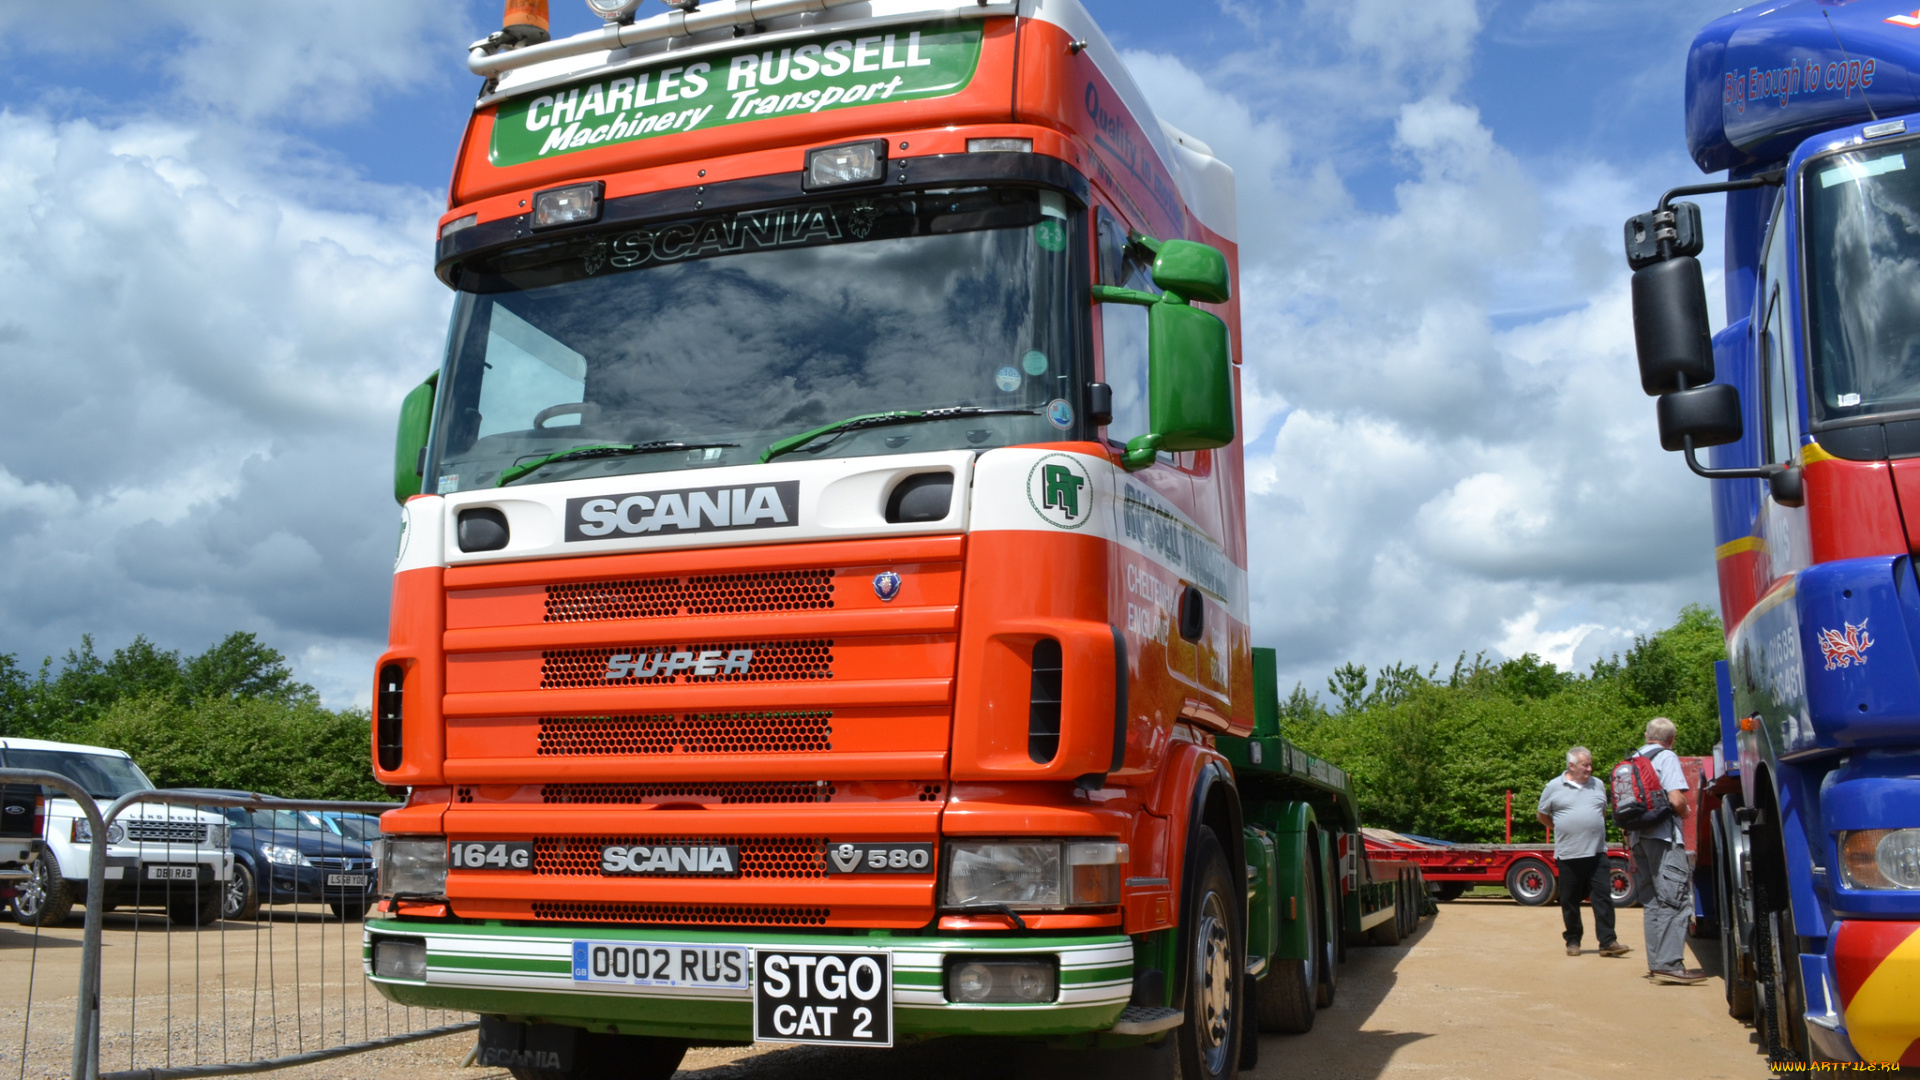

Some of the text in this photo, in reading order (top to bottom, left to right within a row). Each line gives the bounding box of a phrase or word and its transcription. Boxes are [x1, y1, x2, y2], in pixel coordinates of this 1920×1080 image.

[525, 31, 932, 132] CHARLES RUSSELL
[1724, 58, 1876, 115] Big Enough to cope
[539, 76, 904, 155] Machinery Transport
[1085, 81, 1137, 177] Quality
[610, 204, 842, 268] SCANIA
[579, 486, 789, 537] SCANIA
[605, 648, 754, 678] SUPER
[1769, 626, 1795, 668] 01685
[451, 843, 529, 869] 164G
[602, 846, 734, 873] SCANIA
[868, 849, 929, 869] 580
[175, 868, 192, 878] RAB
[575, 968, 587, 976] GB
[681, 949, 742, 982] RUS
[763, 954, 882, 1000] STGO
[773, 1005, 873, 1038] CAT 2
[484, 1046, 561, 1070] SCANIA
